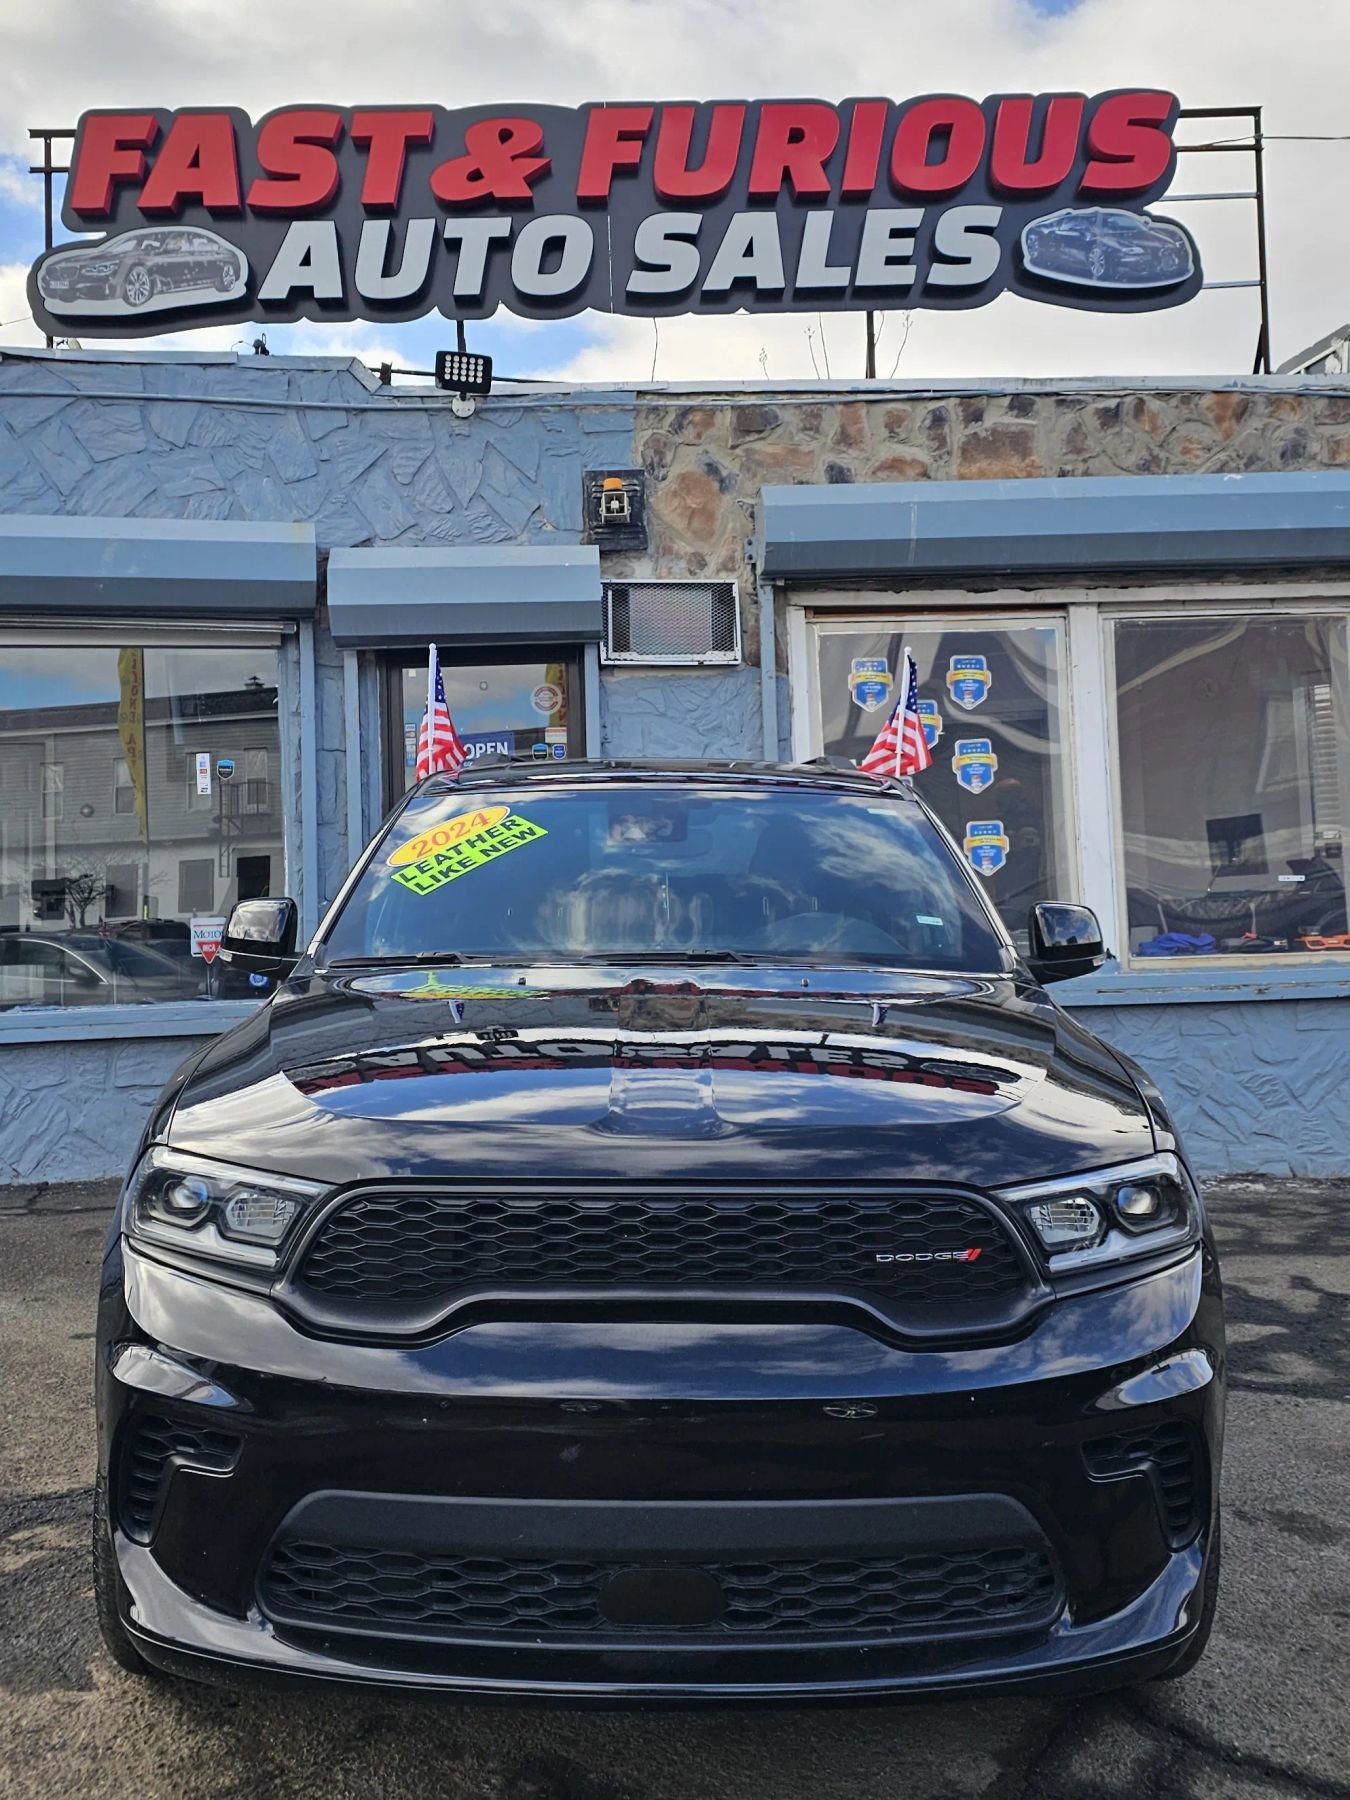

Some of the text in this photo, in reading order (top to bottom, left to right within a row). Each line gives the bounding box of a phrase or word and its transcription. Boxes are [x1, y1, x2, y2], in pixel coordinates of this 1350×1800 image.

[71, 91, 1175, 215] FAST & FURIOUS
[256, 205, 1004, 304] AUTO SALES
[464, 741, 509, 760] OPEN
[398, 818, 521, 883] LEATHER
[411, 812, 489, 858] 2024
[414, 826, 537, 892] LIKE NEW
[193, 929, 224, 940] MOTO
[876, 1251, 969, 1262] DODGE
